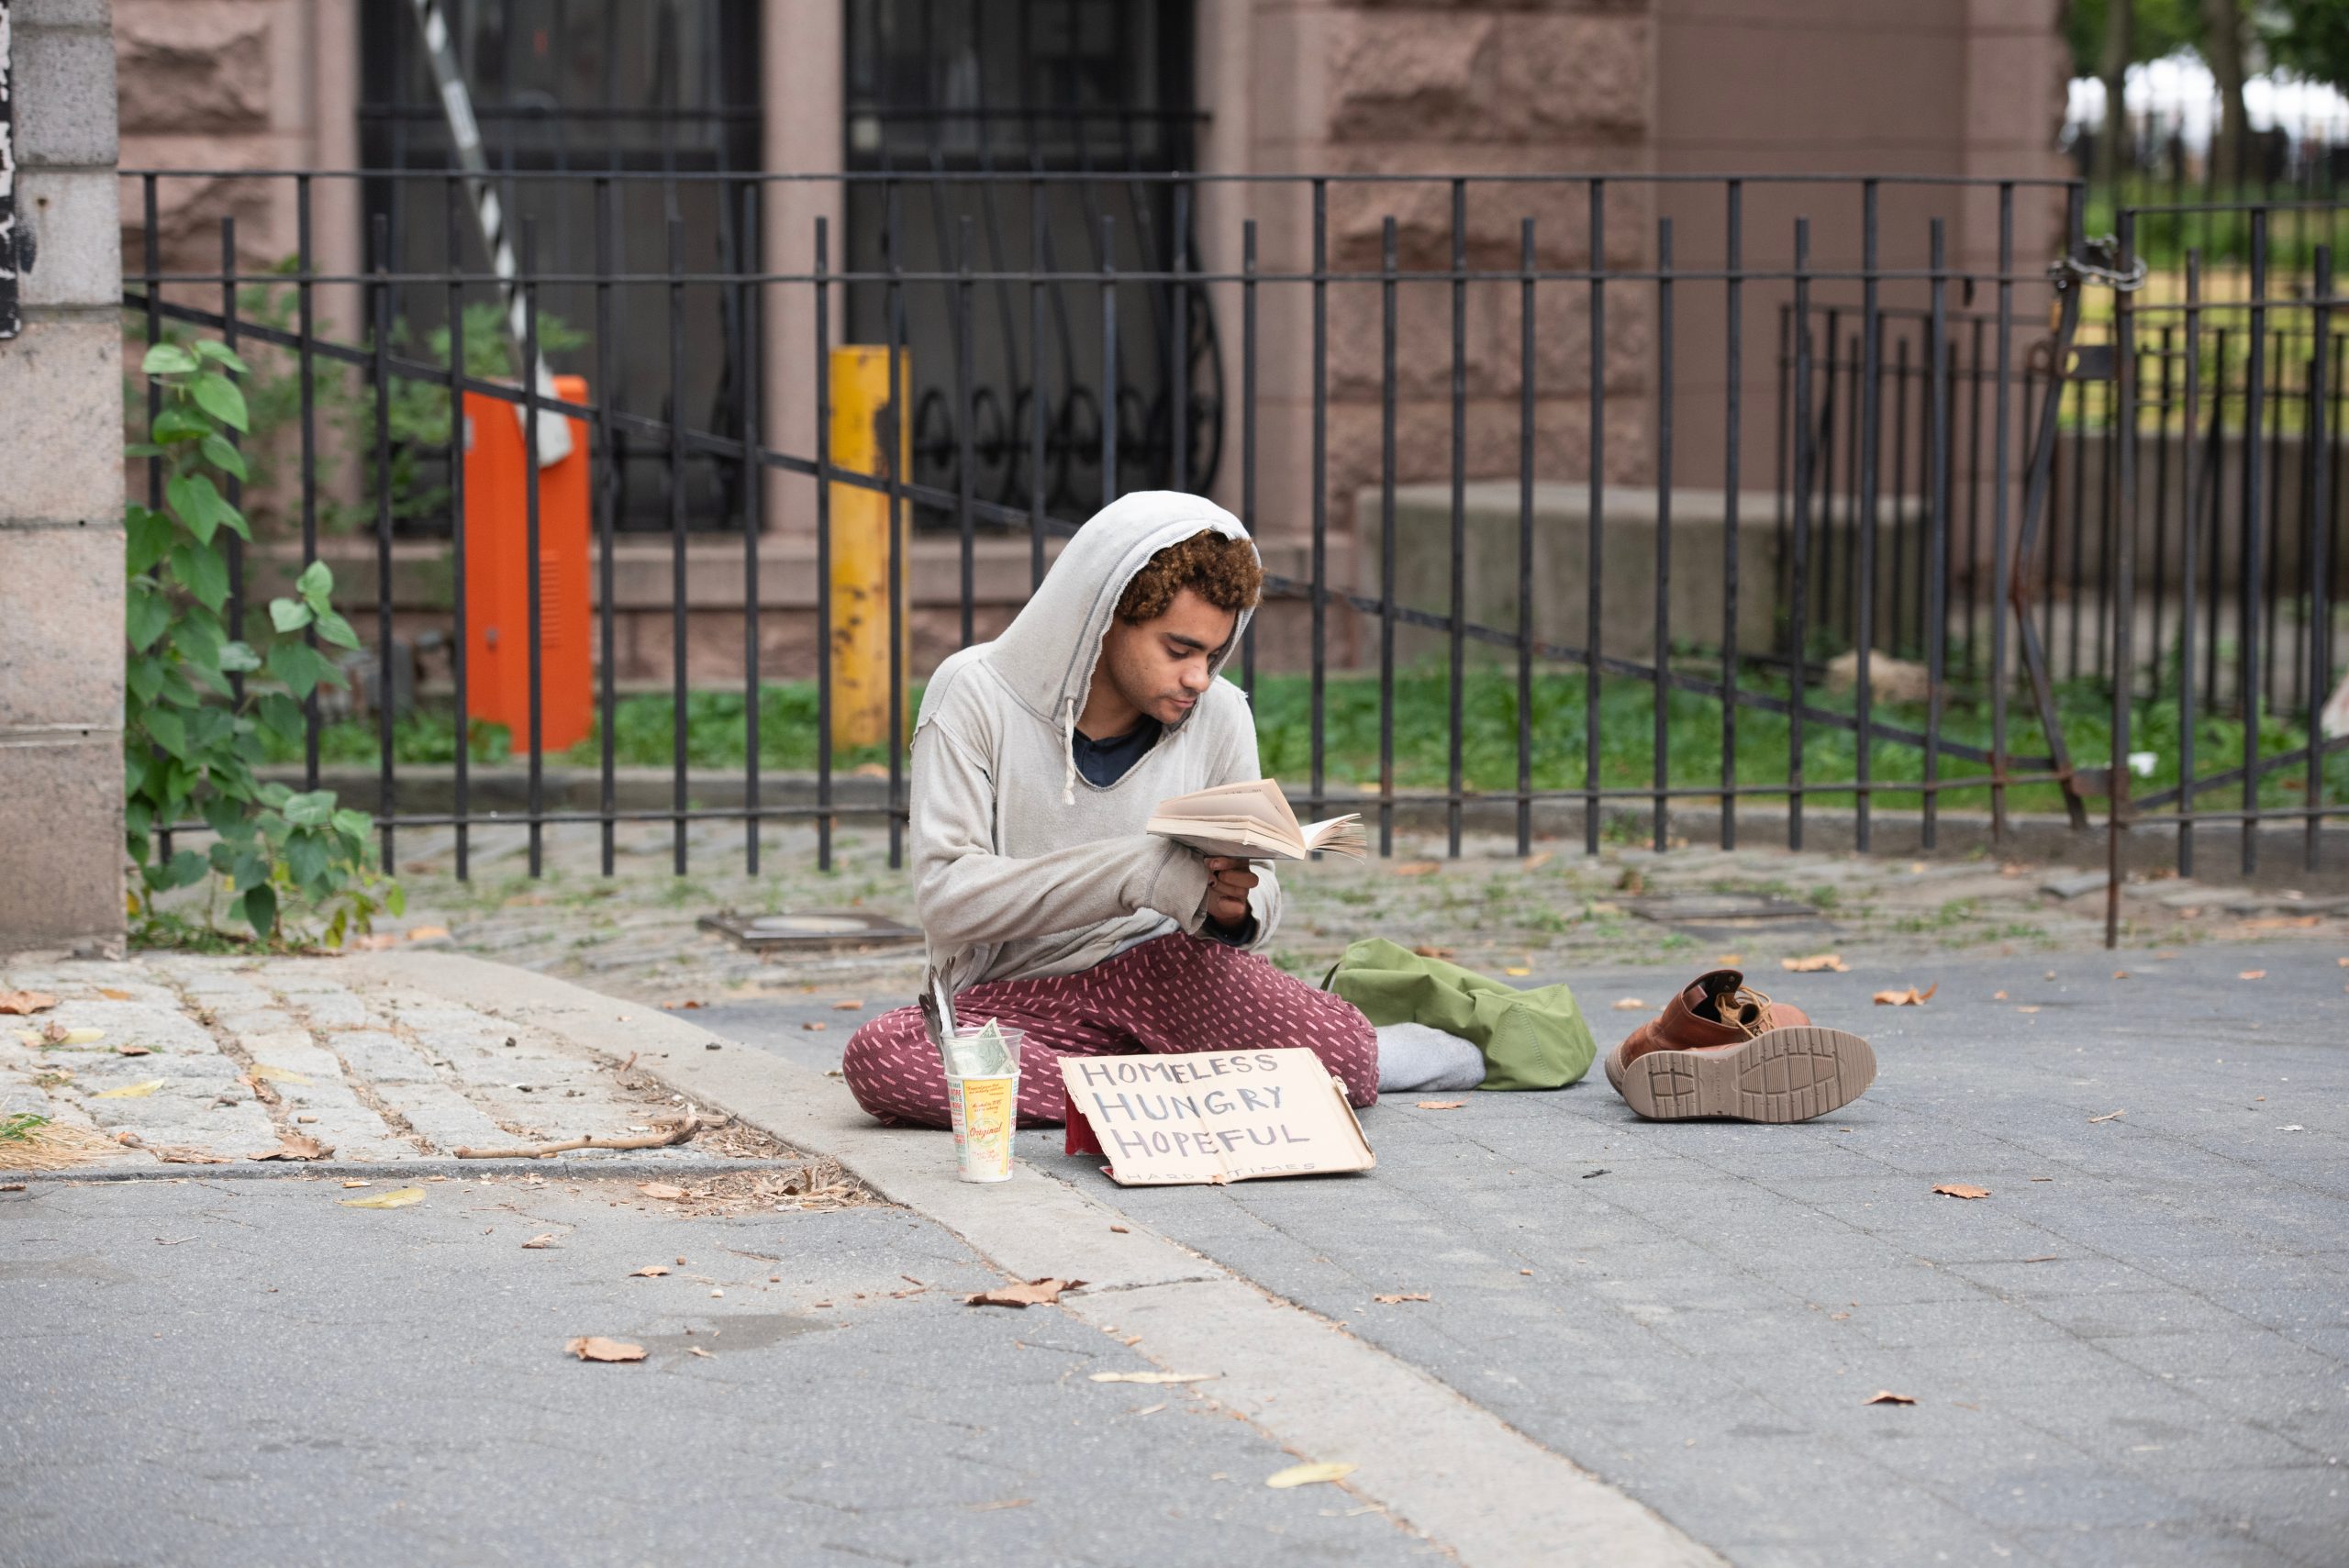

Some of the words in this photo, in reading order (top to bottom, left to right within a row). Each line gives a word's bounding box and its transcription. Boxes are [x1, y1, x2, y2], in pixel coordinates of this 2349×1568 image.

[1079, 1054, 1278, 1087] HOMELESS
[1092, 1085, 1283, 1123] HUNGRY
[969, 1122, 1003, 1140] Original
[1110, 1125, 1310, 1160] HOPEFUL
[1226, 1162, 1316, 1178] TIMES
